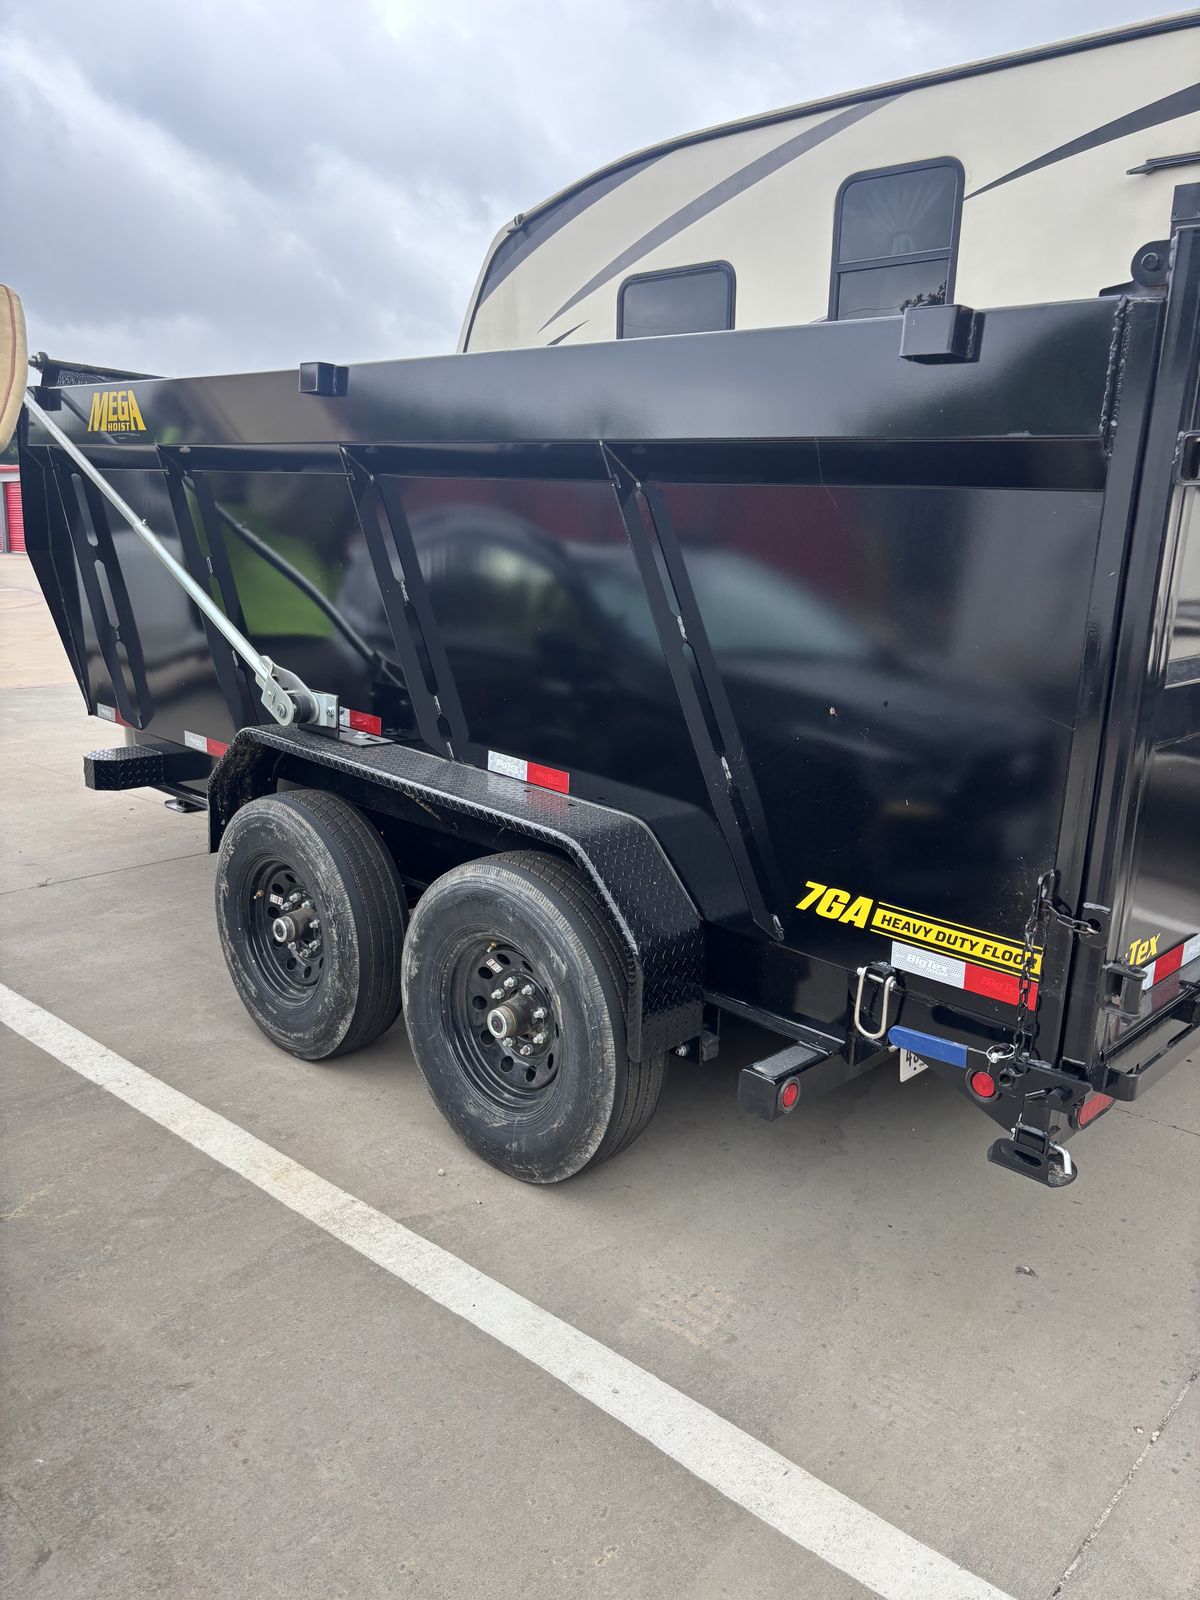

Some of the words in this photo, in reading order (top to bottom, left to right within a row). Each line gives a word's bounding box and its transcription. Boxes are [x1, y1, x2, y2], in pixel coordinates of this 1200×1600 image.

[88, 390, 147, 432] MEGA
[107, 422, 131, 431] HOIST
[795, 880, 874, 929] 7GA
[880, 914, 934, 938] HEAVY
[934, 931, 981, 952] DUTY
[906, 953, 948, 973] BigTex
